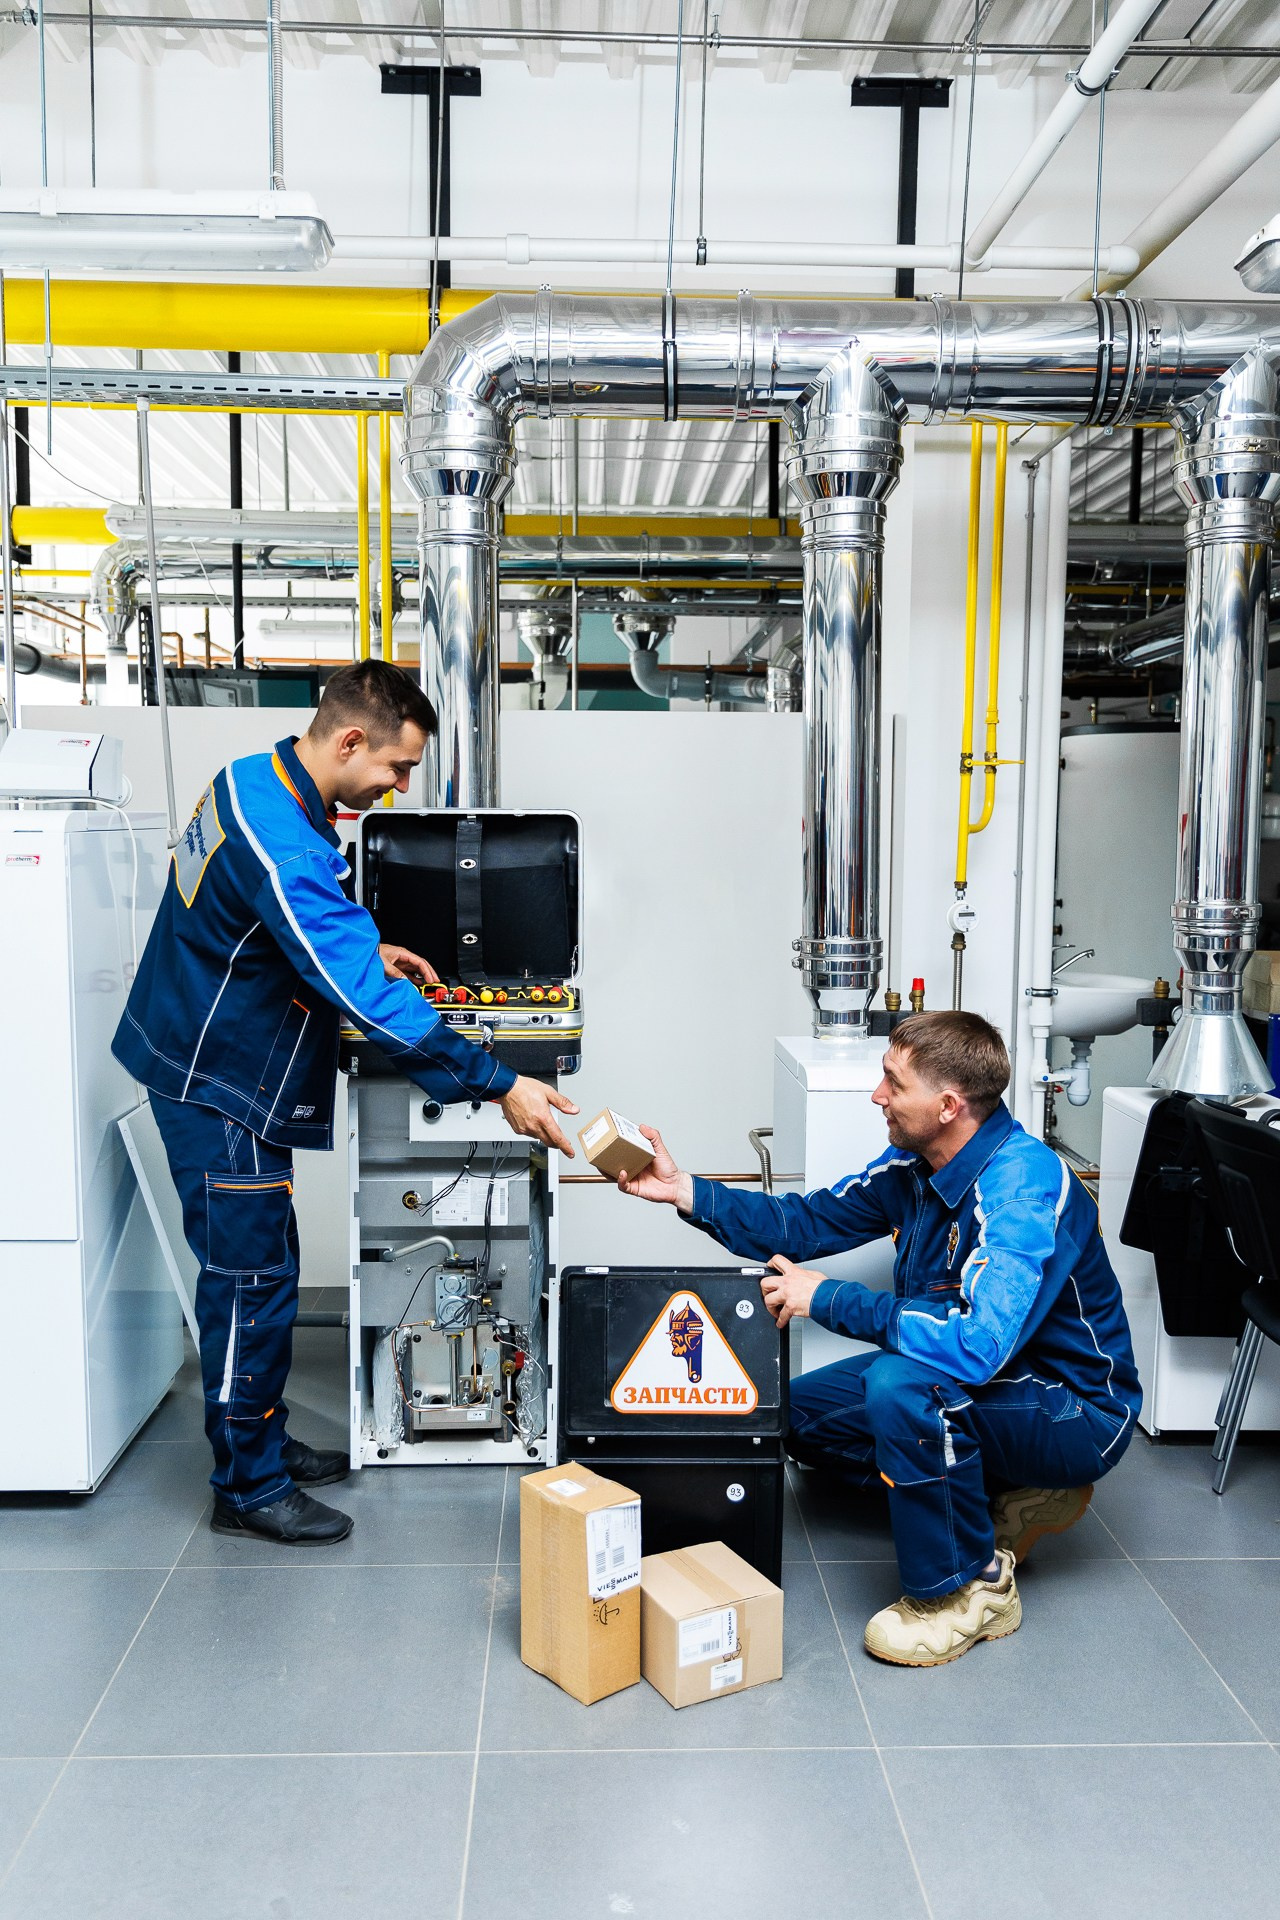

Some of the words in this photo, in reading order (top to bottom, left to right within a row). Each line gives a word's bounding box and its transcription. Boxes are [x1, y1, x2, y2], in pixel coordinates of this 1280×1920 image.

[623, 1387, 748, 1404] ЗАПЧАСТИ
[730, 1487, 742, 1497] 93
[597, 1571, 639, 1592] VIESSMANN
